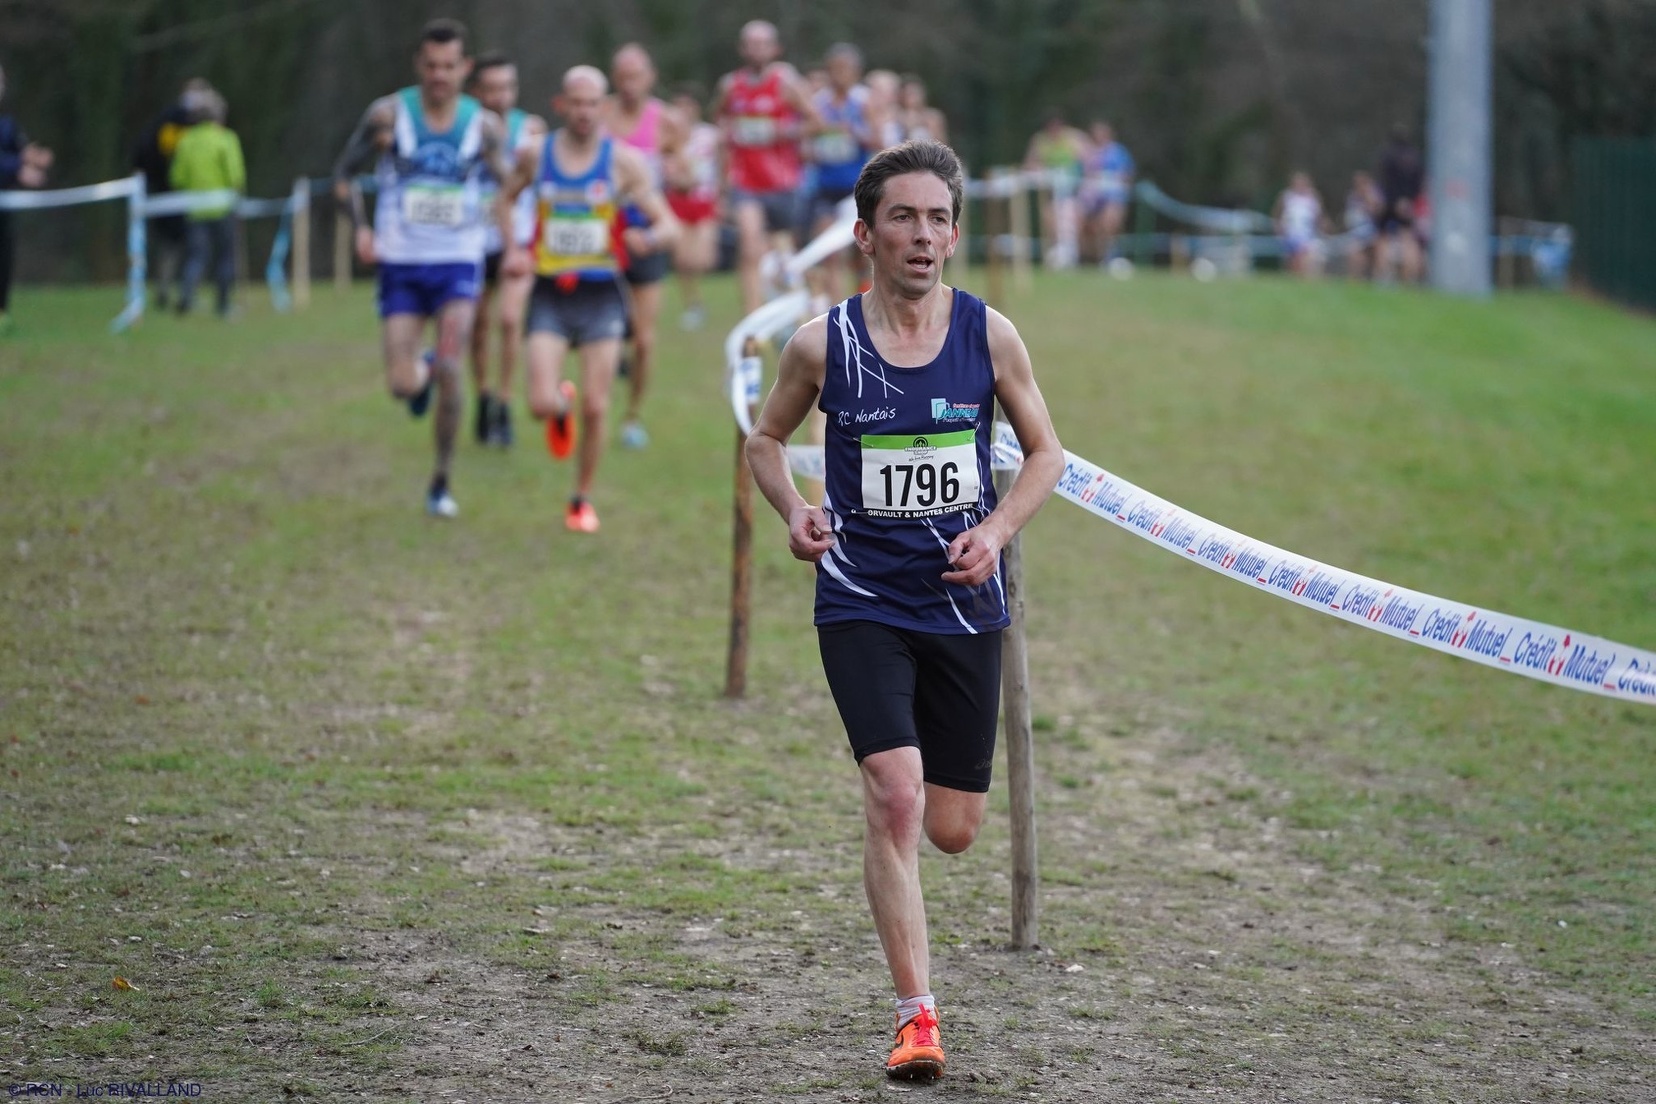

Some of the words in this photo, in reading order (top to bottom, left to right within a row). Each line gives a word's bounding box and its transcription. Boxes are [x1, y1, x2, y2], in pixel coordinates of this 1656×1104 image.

[838, 411, 850, 426] RC
[855, 406, 896, 423] Nantais
[880, 462, 960, 507] 1796
[867, 510, 902, 518] ORVAULT
[913, 507, 943, 517] NANTES
[1422, 608, 1462, 643] Crédit
[1514, 632, 1557, 671] Crédit
